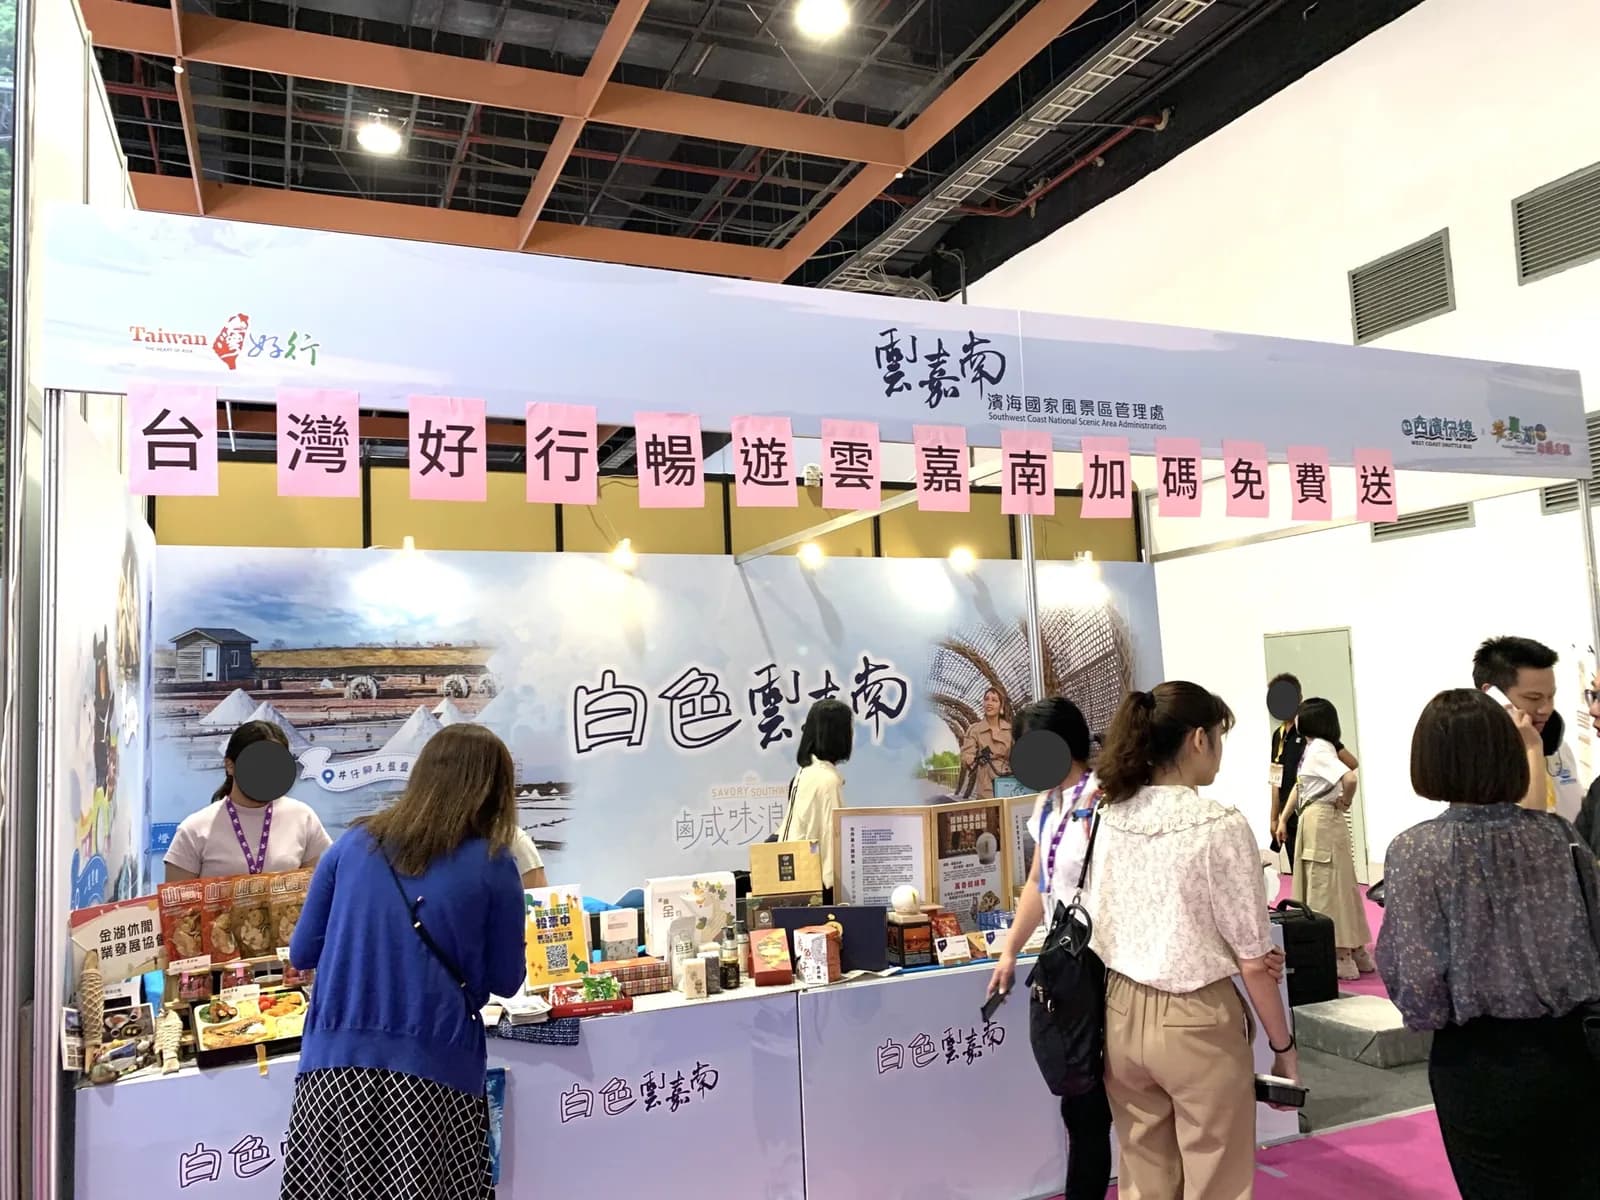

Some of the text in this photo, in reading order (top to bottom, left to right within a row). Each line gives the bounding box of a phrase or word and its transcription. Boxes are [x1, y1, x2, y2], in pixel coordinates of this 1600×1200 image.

[129, 326, 208, 346] Taiwan
[875, 328, 1006, 408] 雲嘉南
[987, 393, 1165, 420] 濱海國家風景區管理處
[988, 412, 1167, 430] Southwest Coast National Scenic Area Administration
[573, 656, 907, 754] 白色雲南
[711, 786, 749, 798] SAVORY
[99, 919, 153, 943] 金湖休閒
[877, 1020, 1005, 1074] 白色雲嘉南
[560, 1061, 719, 1123] 白色雲嘉南
